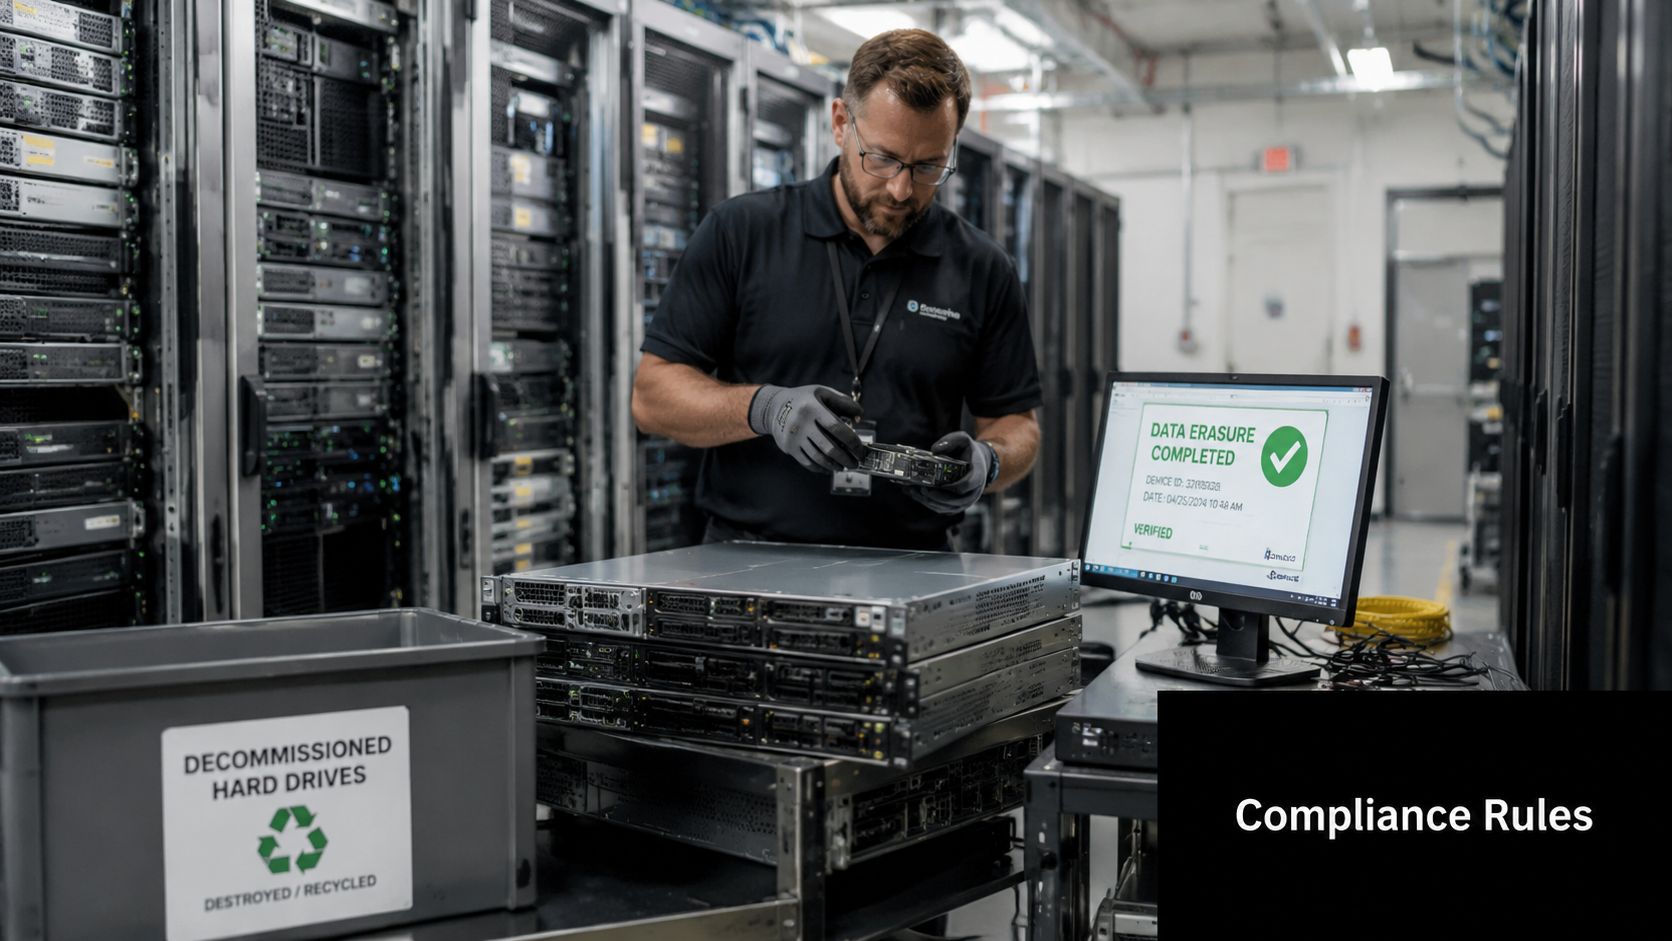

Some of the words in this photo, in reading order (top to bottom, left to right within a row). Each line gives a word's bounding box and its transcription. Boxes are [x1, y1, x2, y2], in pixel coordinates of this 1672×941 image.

[1150, 422, 1186, 439] DATA
[1189, 424, 1256, 443] ERASURE
[1151, 445, 1235, 466] COMPLETED
[1230, 502, 1243, 512] AM
[1134, 523, 1173, 540] VERIFIED
[184, 735, 392, 775] DECOMMISSIONED
[212, 775, 278, 801] HARD
[285, 765, 367, 793] DRIVES
[204, 887, 292, 912] DESTROYED
[294, 885, 302, 899] /
[304, 874, 377, 897] RECYCLED
